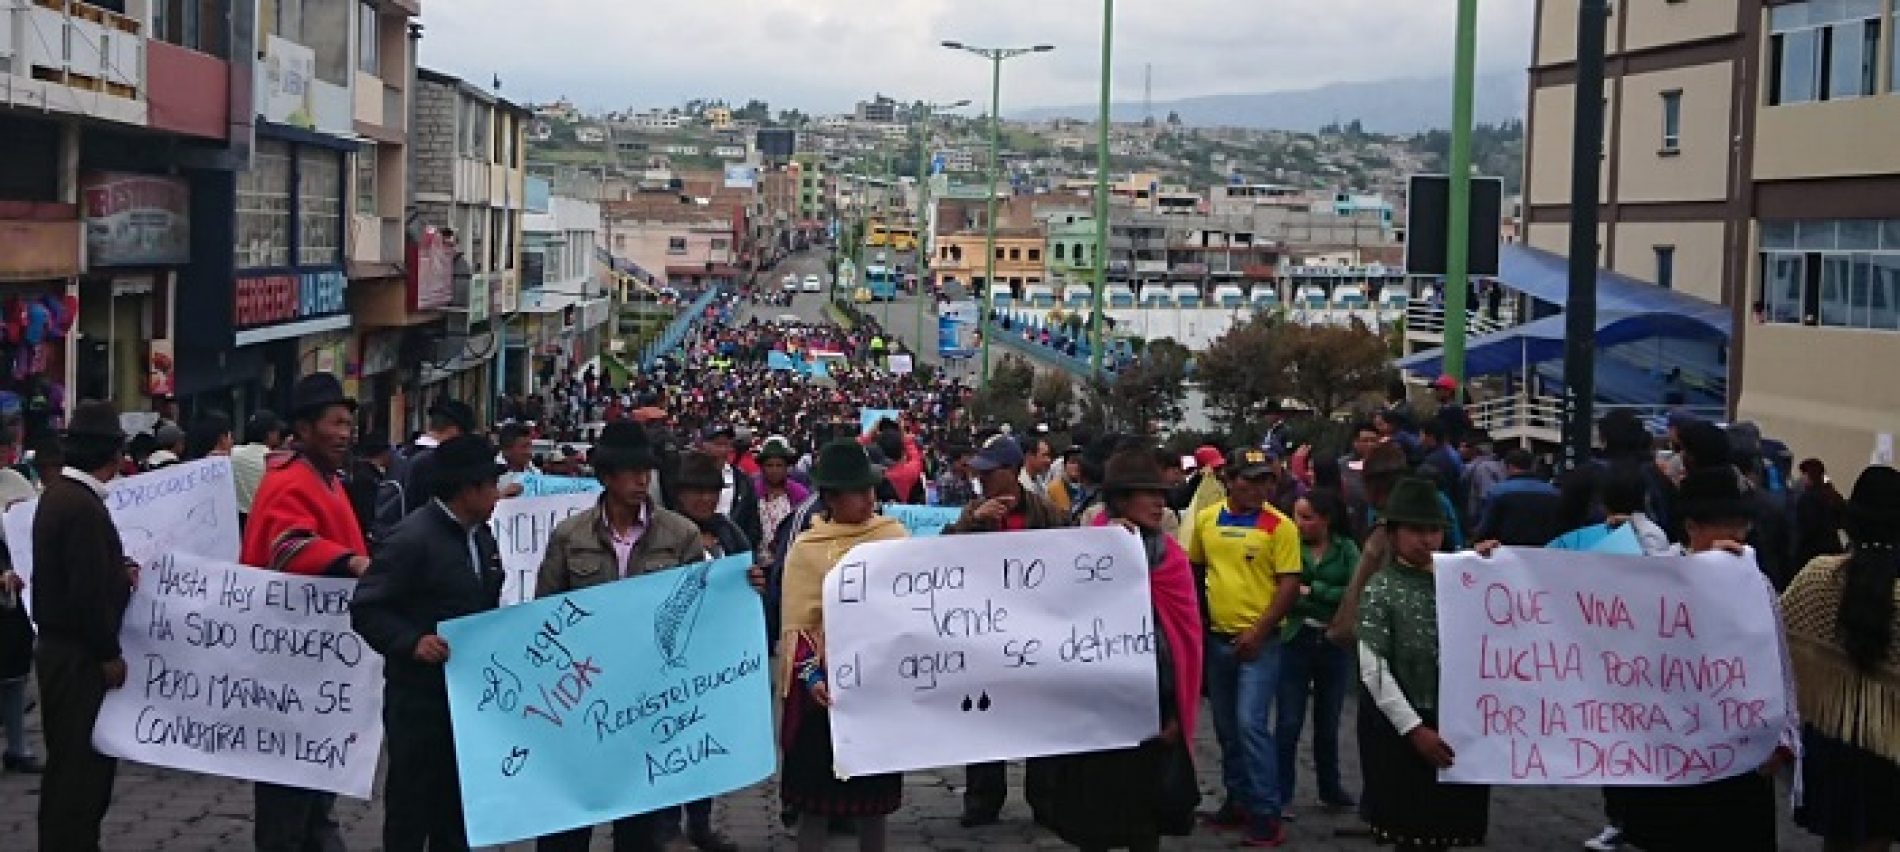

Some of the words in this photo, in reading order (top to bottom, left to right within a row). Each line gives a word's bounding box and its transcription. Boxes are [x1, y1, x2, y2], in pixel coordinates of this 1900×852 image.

[266, 580, 296, 612] EL
[838, 561, 867, 603] El
[893, 566, 965, 611] agua
[1003, 558, 1046, 590] no
[1074, 553, 1114, 583] se
[150, 602, 174, 641] HA
[185, 611, 236, 649] SIDO
[251, 623, 362, 667] CORDERO
[931, 599, 1008, 638] vende
[1576, 590, 1635, 631] VIVA
[1658, 596, 1695, 640] LA
[144, 654, 198, 700] PERO
[206, 673, 303, 714] MAÑANA
[315, 680, 352, 714] SE
[836, 652, 862, 690] el
[900, 650, 966, 692] agua
[1003, 638, 1042, 668] se
[1479, 633, 1584, 682] LUCHA
[1601, 651, 1653, 689] POR
[523, 656, 603, 728] VIDA
[1477, 694, 1528, 738] POR
[1541, 697, 1567, 736] LA
[1572, 698, 1673, 733] TIERRA
[1717, 697, 1768, 731] POR
[257, 727, 285, 755] EN
[651, 705, 706, 744] DEL
[646, 732, 731, 787] AGUA
[1511, 738, 1547, 780] LA
